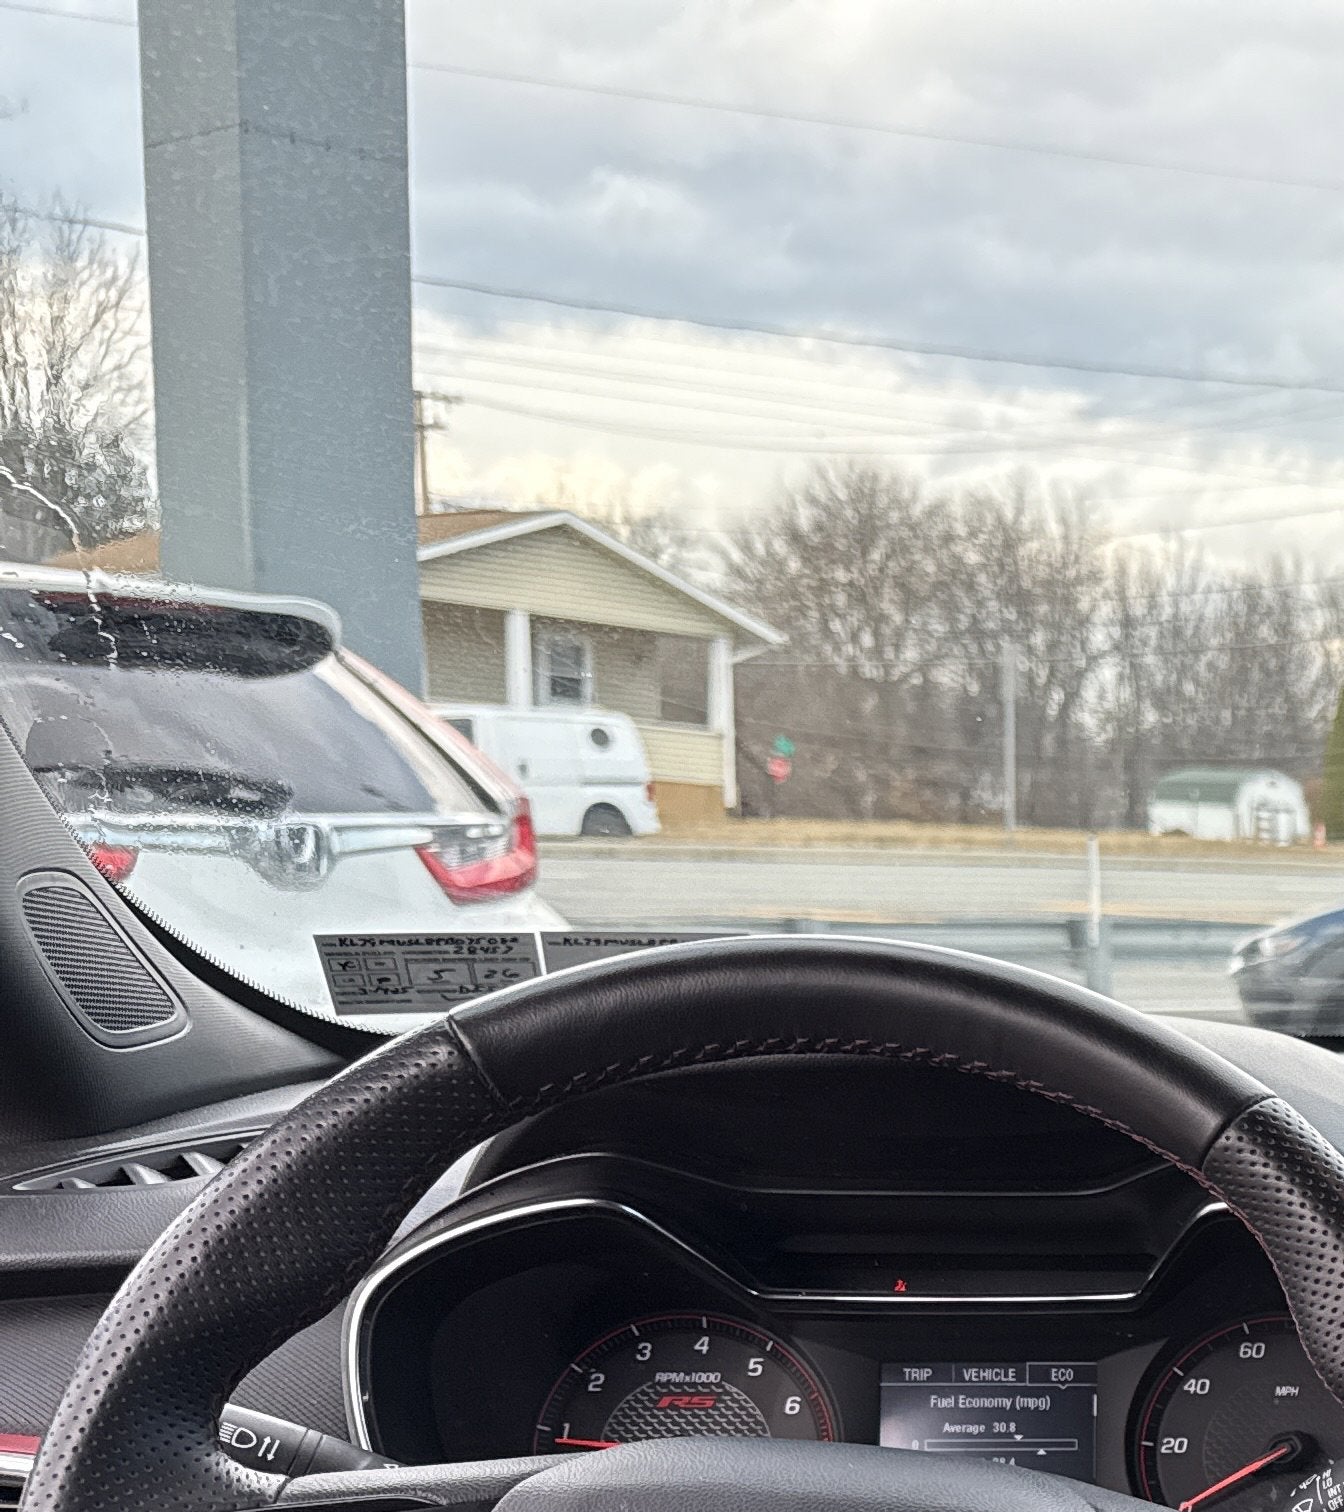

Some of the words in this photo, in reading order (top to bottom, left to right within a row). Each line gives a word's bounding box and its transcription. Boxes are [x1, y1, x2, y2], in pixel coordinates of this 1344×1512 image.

[636, 1342, 652, 1361] 3
[694, 1336, 710, 1354] 4
[1239, 1343, 1265, 1358] 60
[747, 1358, 764, 1377] 5
[903, 1368, 932, 1381] TRIP
[963, 1368, 1016, 1381] VEHICLE
[1051, 1368, 1074, 1381] ECO
[588, 1373, 605, 1391] 2
[654, 1372, 721, 1384] RPMx1000
[1183, 1379, 1210, 1395] 40
[1275, 1386, 1299, 1397] MPH
[658, 1396, 716, 1408] RS
[784, 1396, 802, 1415] 6
[930, 1395, 955, 1408] Fuel
[959, 1395, 1012, 1410] Economy
[1016, 1395, 1050, 1411] (mpg)
[943, 1422, 985, 1434] Average
[993, 1422, 1016, 1433] 30.8
[1161, 1437, 1188, 1453] 20
[1322, 1477, 1333, 1489] LO
[1327, 1484, 1342, 1498] INT
[1327, 1495, 1344, 1511] OFF
